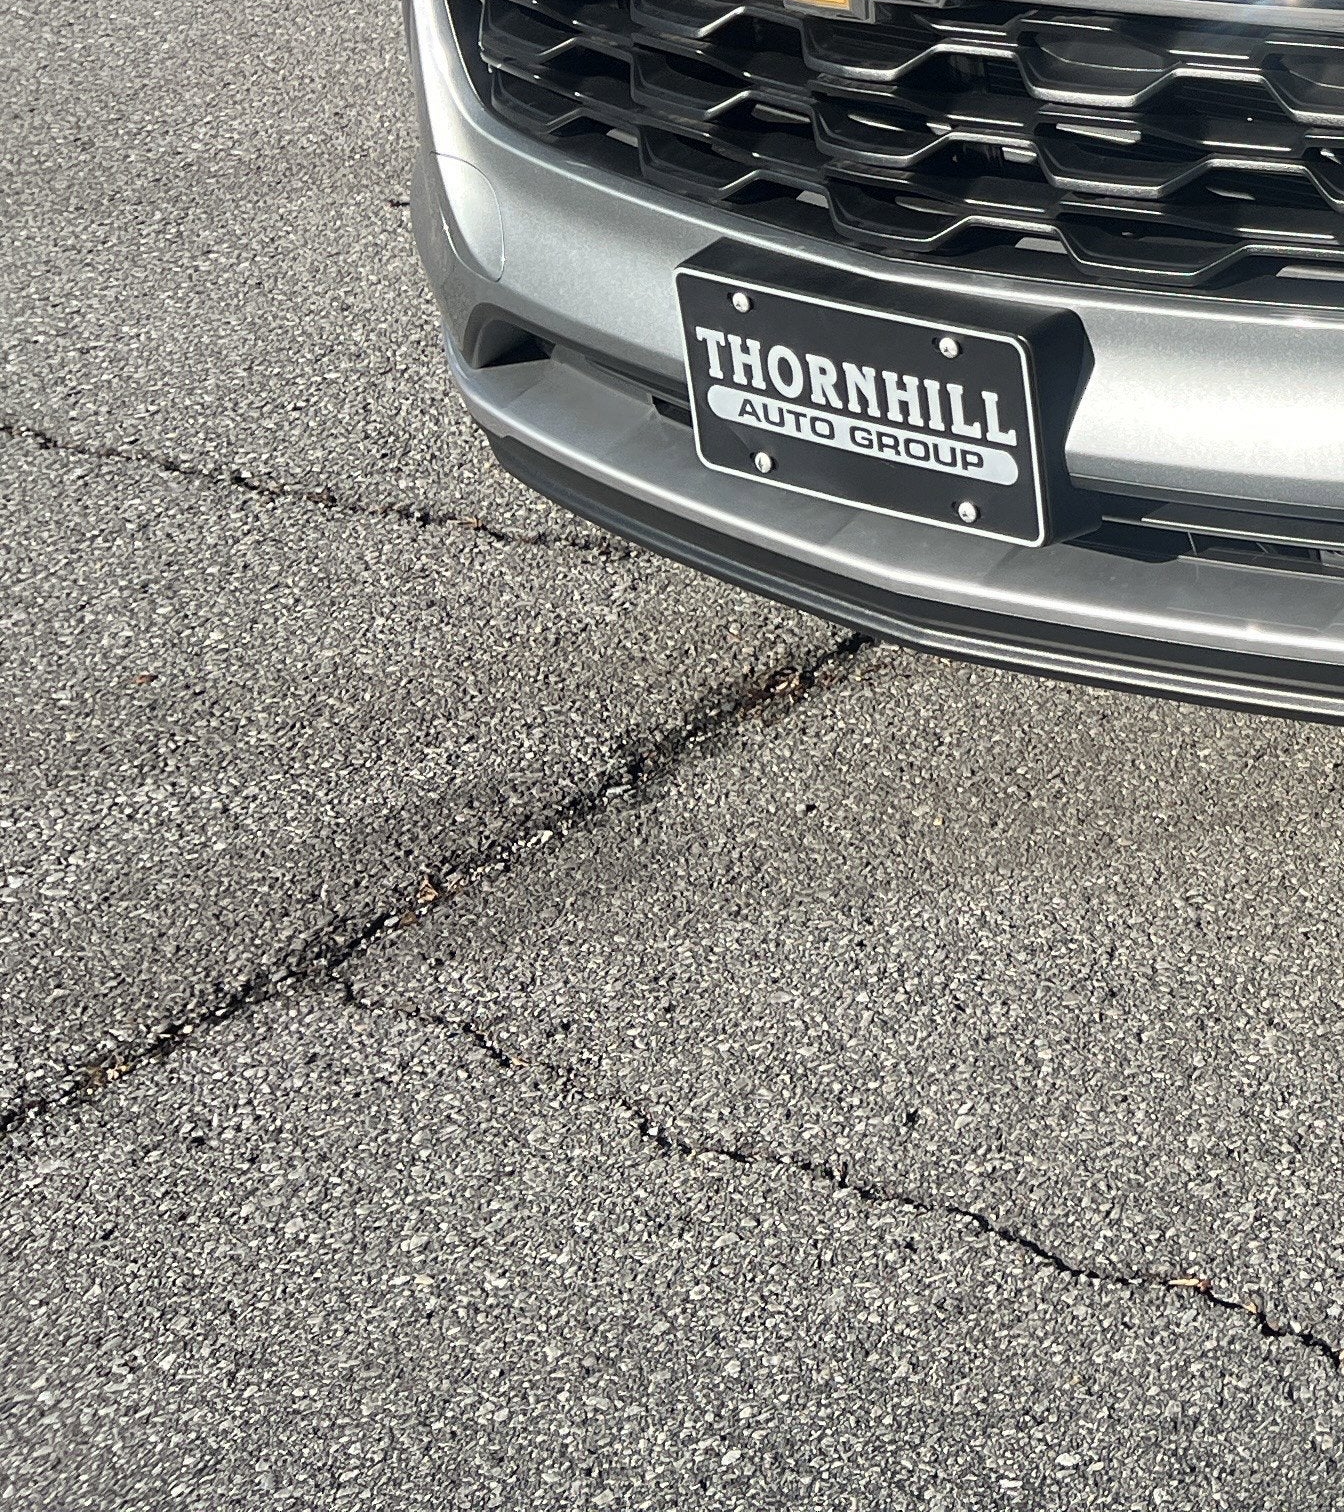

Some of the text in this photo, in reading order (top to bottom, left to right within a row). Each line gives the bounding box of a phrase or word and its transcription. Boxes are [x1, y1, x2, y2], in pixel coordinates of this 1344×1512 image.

[696, 326, 1017, 446] THORNHILL
[738, 398, 984, 472] AUTO GROUP
